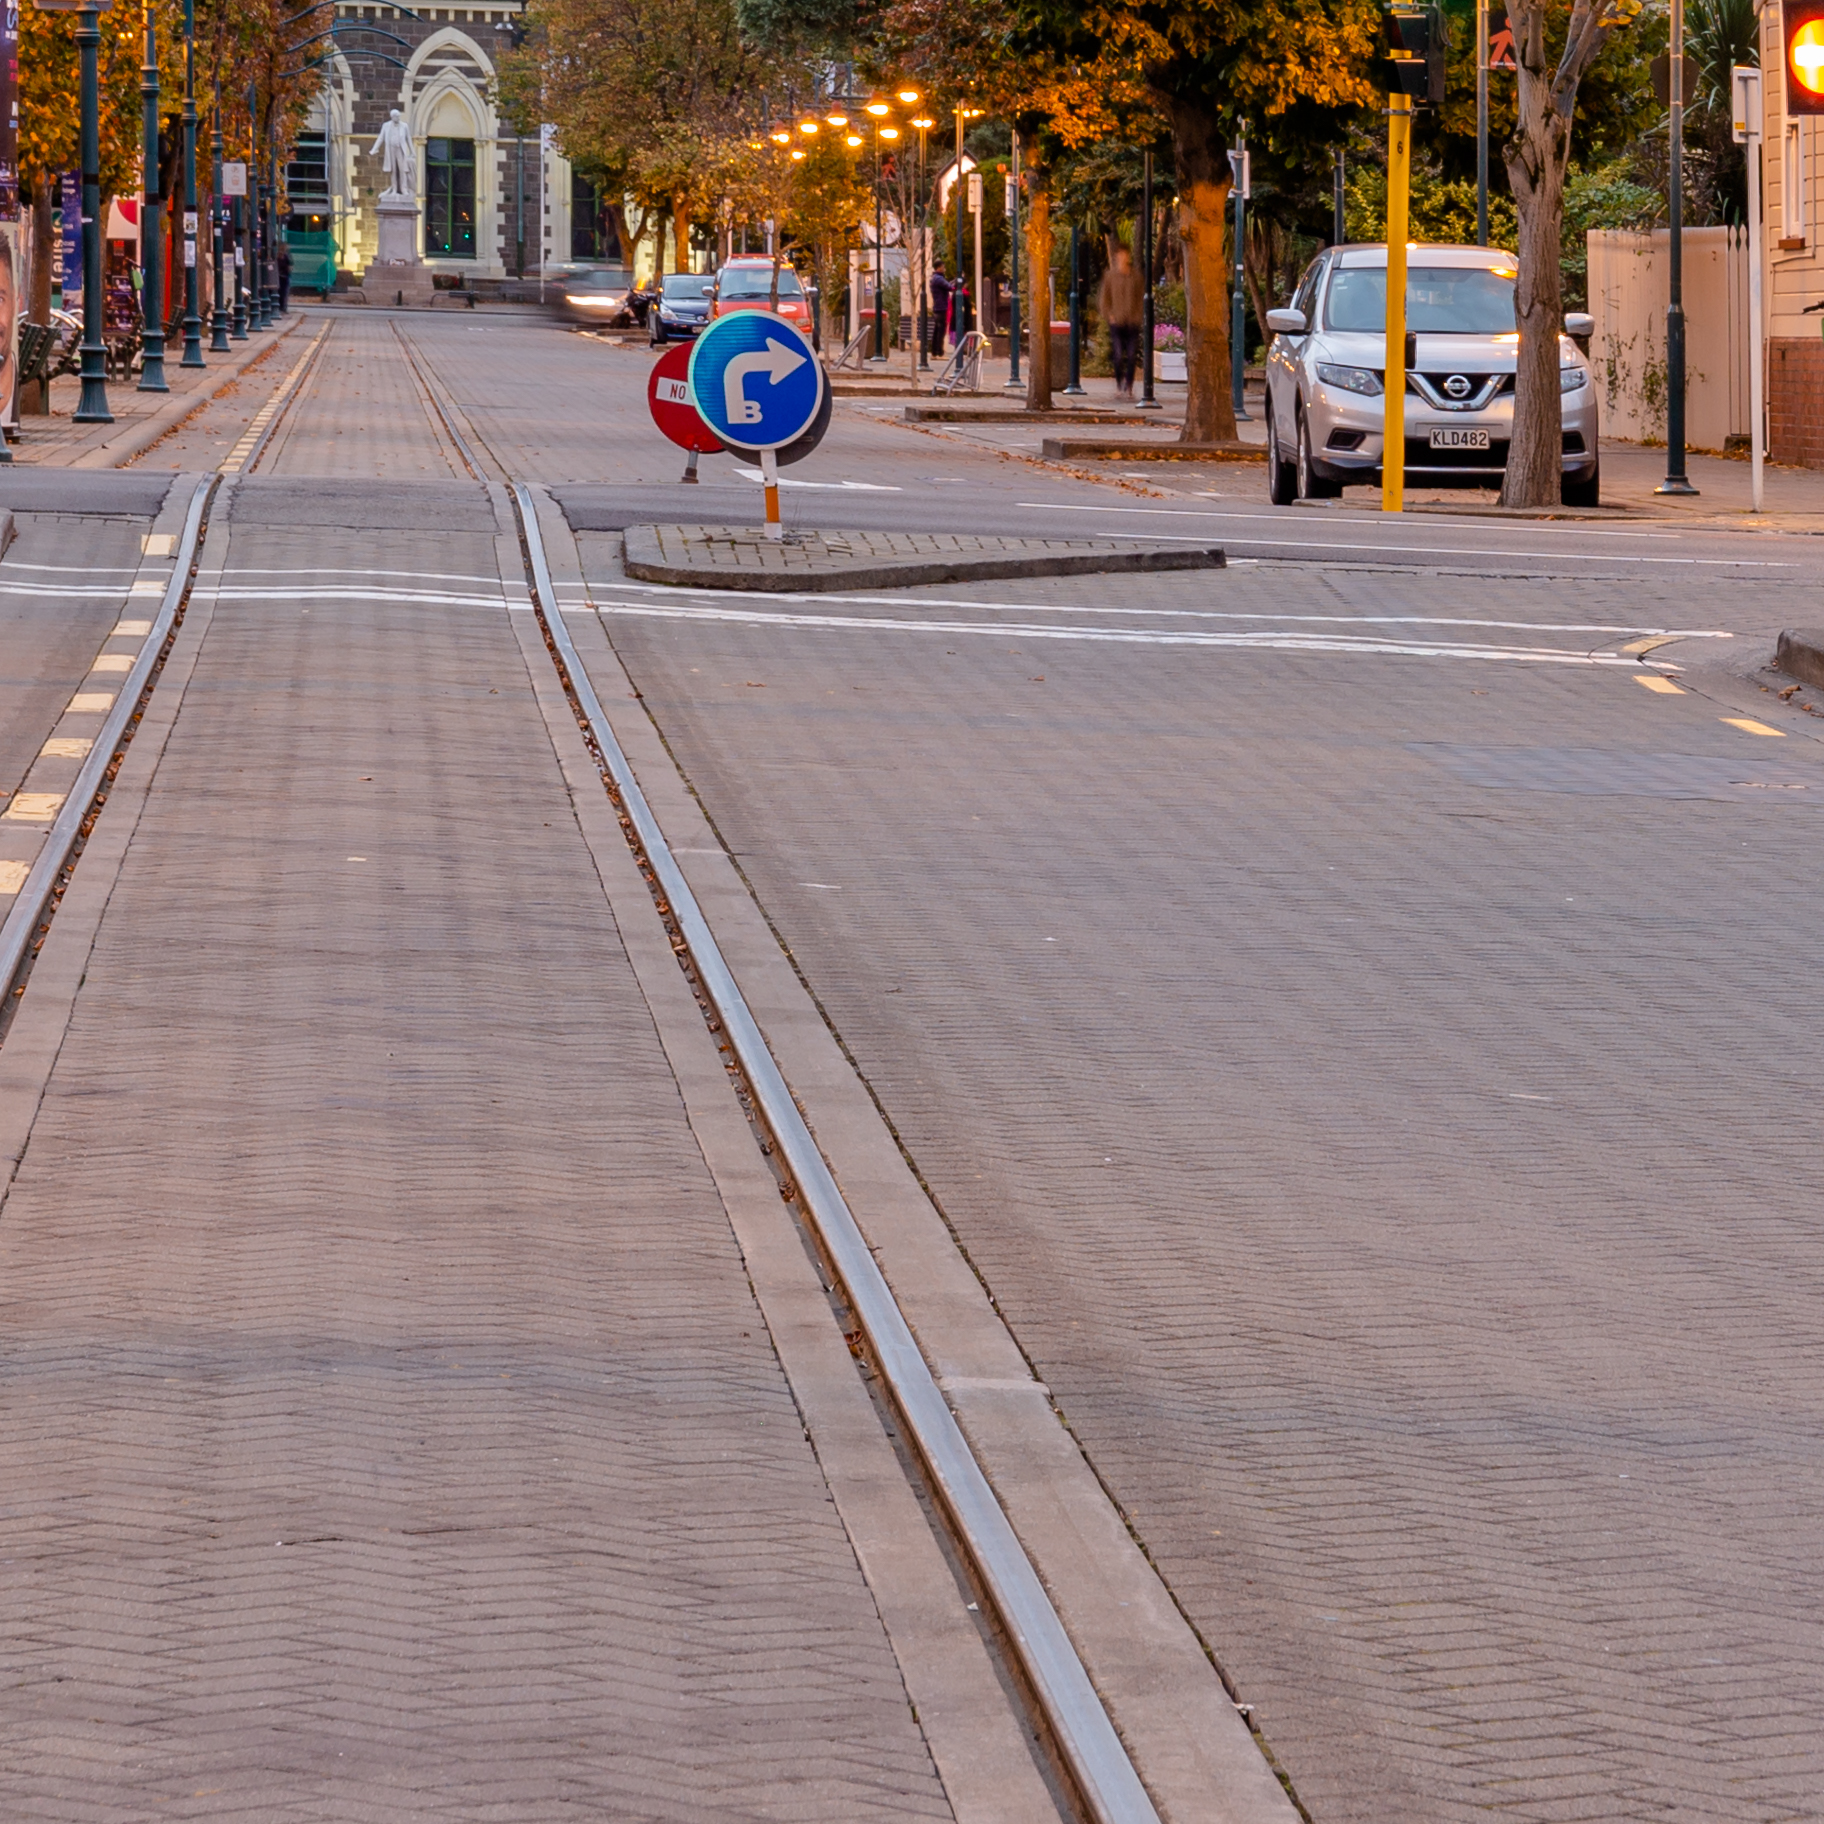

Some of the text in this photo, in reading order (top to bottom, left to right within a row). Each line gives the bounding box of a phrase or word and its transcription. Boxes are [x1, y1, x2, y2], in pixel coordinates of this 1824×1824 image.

[1397, 141, 1403, 154] 6
[669, 383, 686, 400] NO
[1433, 431, 1487, 446] KLD482
